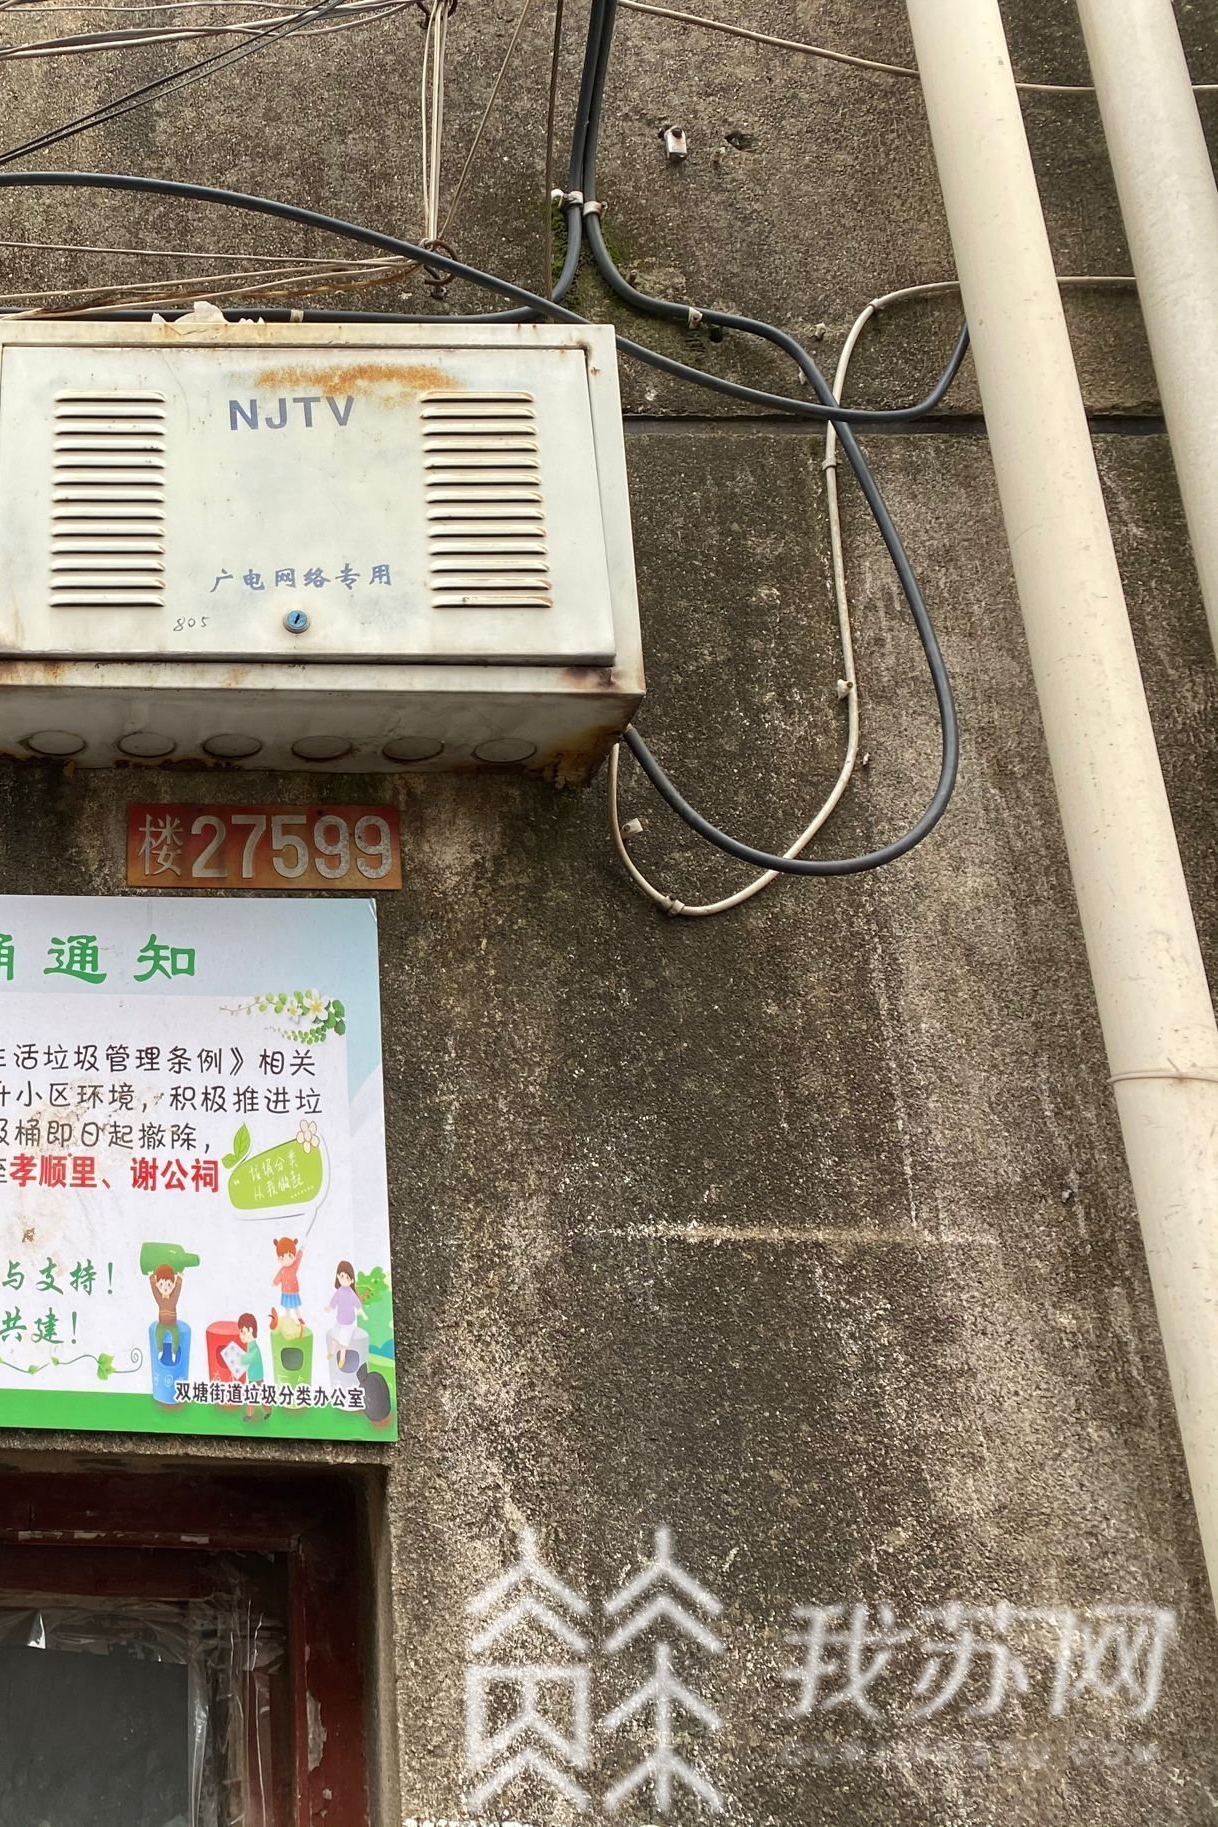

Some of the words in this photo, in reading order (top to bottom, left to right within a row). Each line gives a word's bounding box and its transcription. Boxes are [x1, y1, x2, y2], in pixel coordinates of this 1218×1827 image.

[228, 395, 355, 431] NJTV
[210, 562, 392, 593] 广电网络专用
[137, 813, 393, 881] 楼27599
[175, 1381, 365, 1409] 双塘街道垃圾分类办公室
